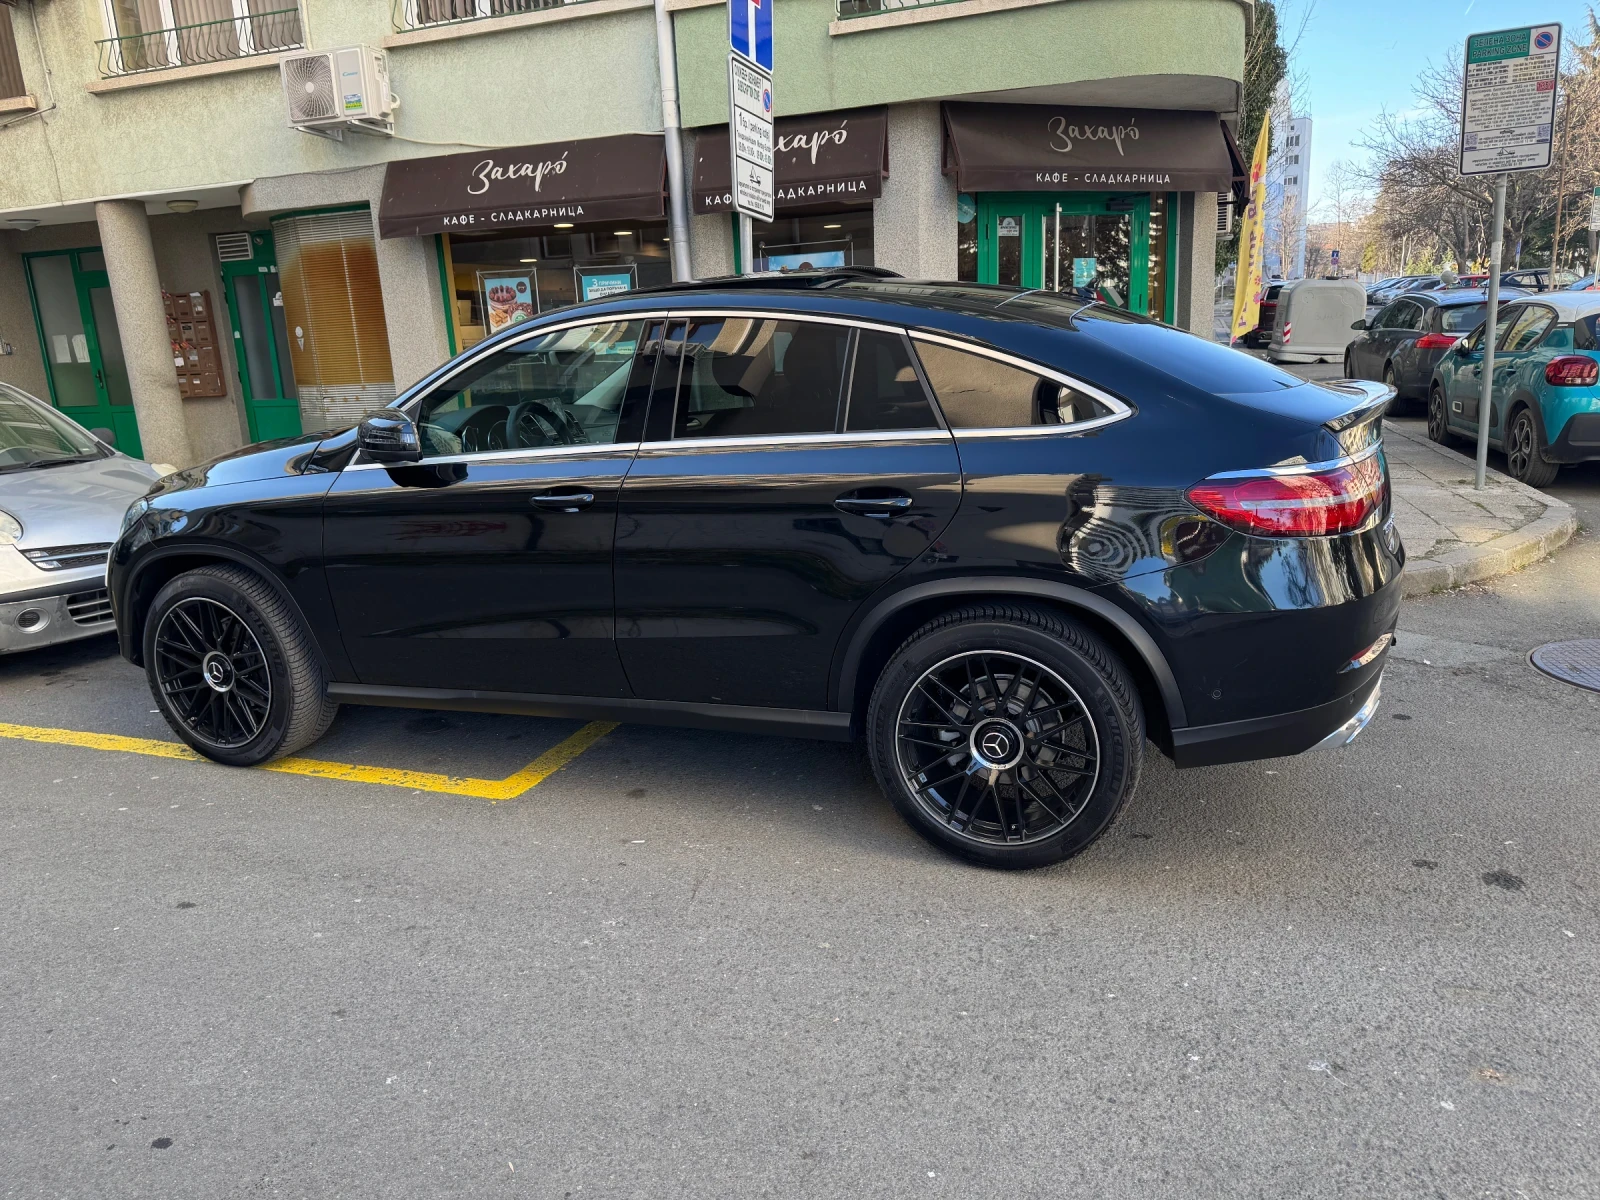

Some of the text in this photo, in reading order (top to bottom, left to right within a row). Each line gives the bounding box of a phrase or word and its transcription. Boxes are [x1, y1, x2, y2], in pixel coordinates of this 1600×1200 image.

[1505, 33, 1527, 44] ЗОНА
[1472, 44, 1527, 58] PARKING ZONE
[1036, 172, 1069, 184] КАФЕ
[1084, 173, 1171, 185] СЛАДКАРНИЦА
[705, 194, 732, 206] КАФ
[773, 181, 867, 200] АДКАРНИЦА
[443, 214, 475, 226] КАФЕ
[490, 205, 585, 222] СЛАДКАРНИЦА
